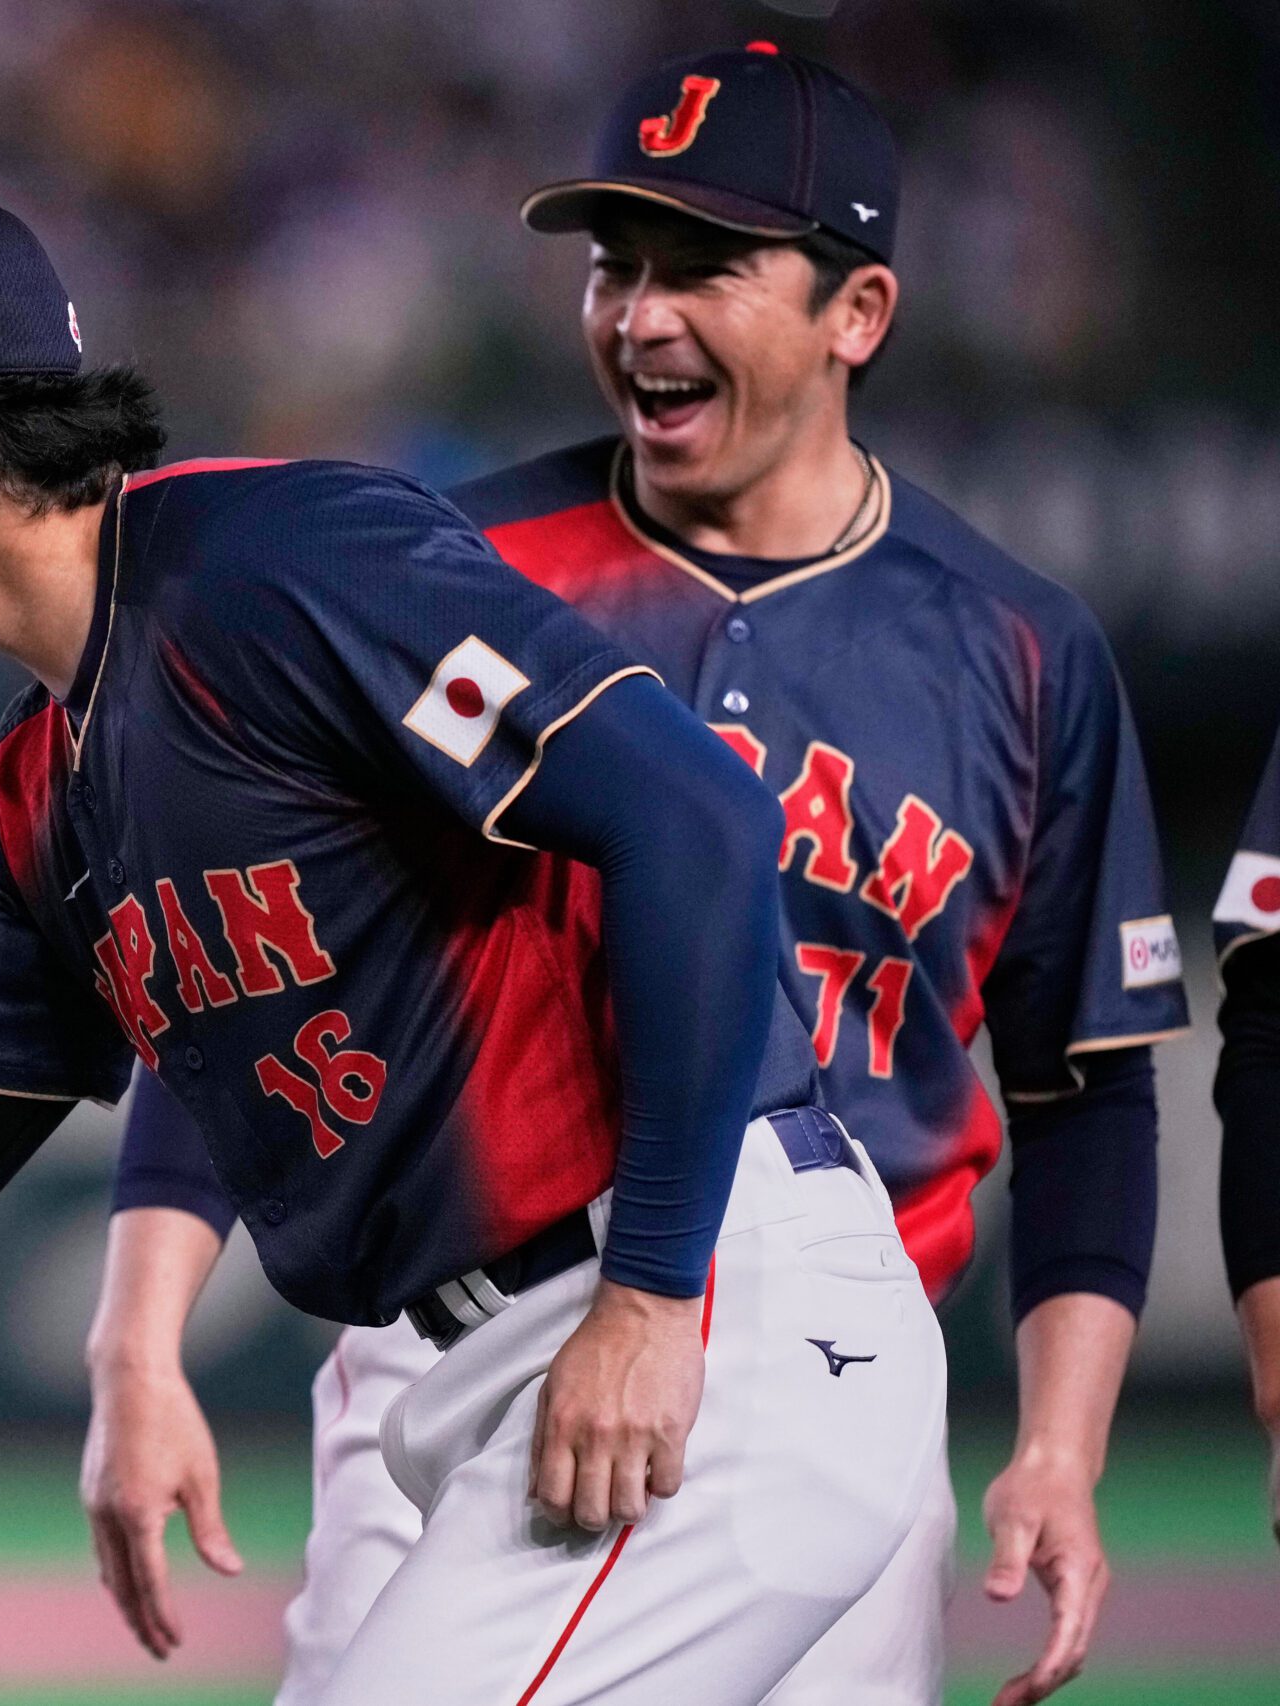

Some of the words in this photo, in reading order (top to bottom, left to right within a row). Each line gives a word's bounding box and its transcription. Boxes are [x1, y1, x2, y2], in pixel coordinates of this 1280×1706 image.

[639, 74, 721, 158] J
[704, 723, 975, 942] AN
[794, 942, 914, 1080] 71
[254, 1009, 387, 1159] 16
